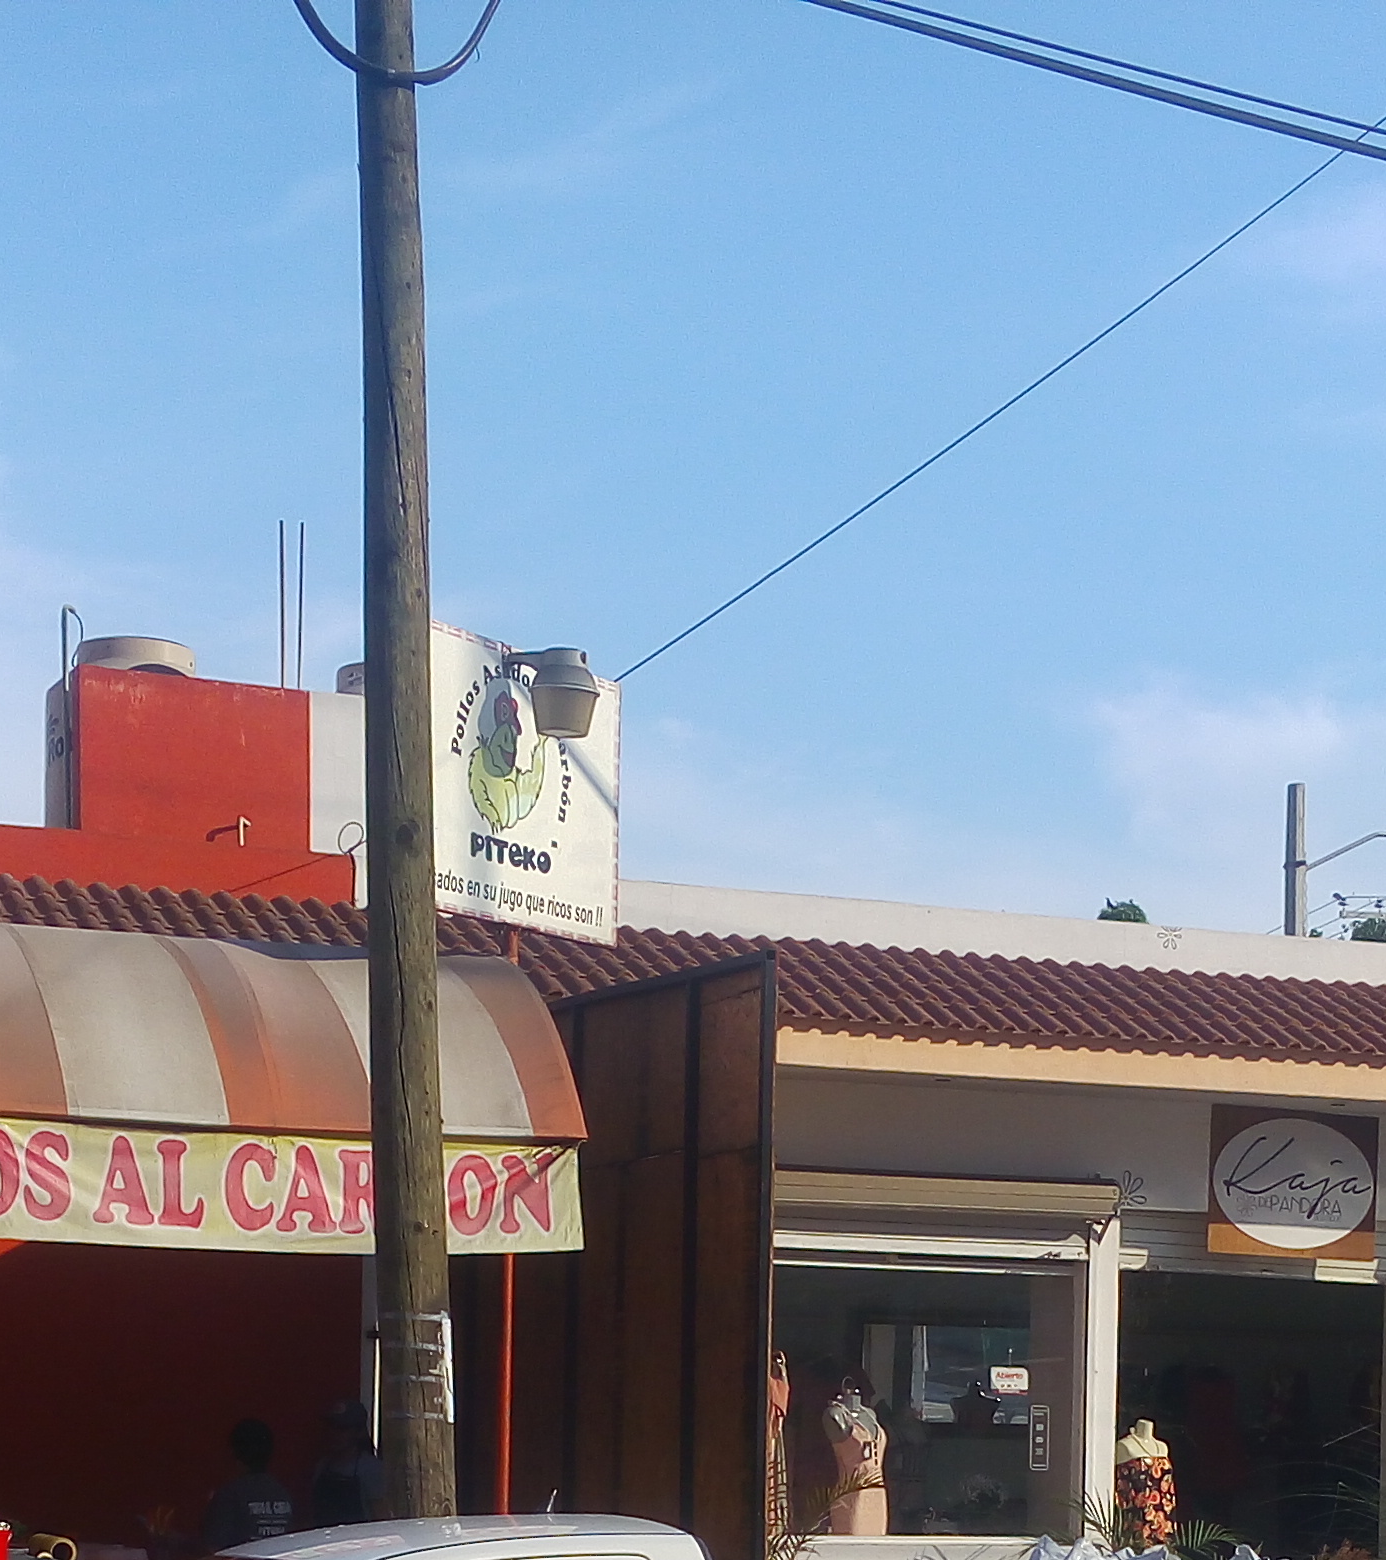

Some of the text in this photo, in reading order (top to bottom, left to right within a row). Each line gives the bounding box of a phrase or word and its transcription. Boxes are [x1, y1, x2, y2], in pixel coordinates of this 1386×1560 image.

[451, 680, 480, 757] Pollos
[558, 742, 572, 823] arbón
[435, 869, 464, 894] ados
[467, 879, 481, 898] en
[483, 883, 497, 901] su
[498, 881, 523, 912] jugo
[525, 893, 545, 916] que
[547, 895, 572, 920] ricos
[575, 905, 594, 925] son
[92, 1134, 207, 1230] AL
[224, 1141, 551, 1237] CARON
[1222, 1136, 1372, 1220] Kaja
[1270, 1195, 1343, 1217] PANDORA
